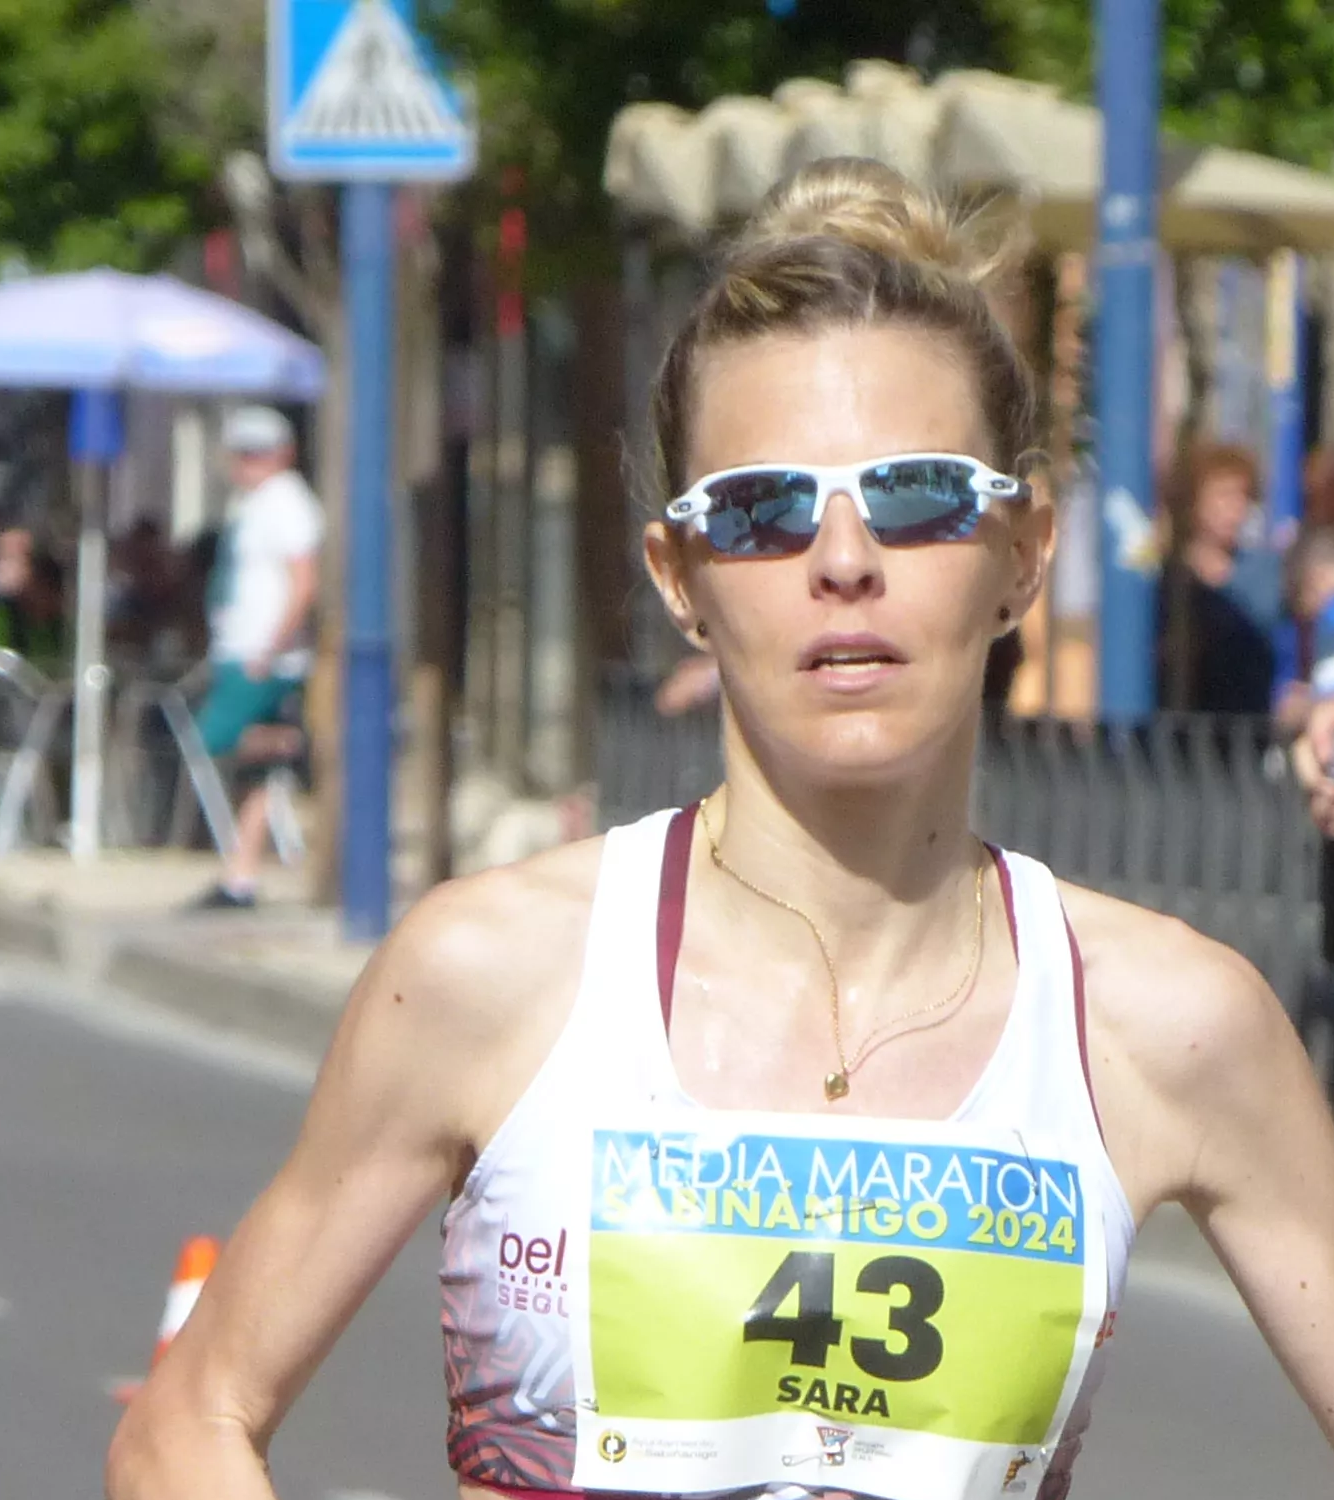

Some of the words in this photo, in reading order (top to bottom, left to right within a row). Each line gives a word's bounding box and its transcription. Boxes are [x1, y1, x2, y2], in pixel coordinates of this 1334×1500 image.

[603, 1138, 789, 1192] MEDIA
[808, 1146, 1077, 1217] MARATON
[968, 1204, 1077, 1255] 2024
[743, 1250, 945, 1382] 43
[775, 1375, 890, 1418] SARA
